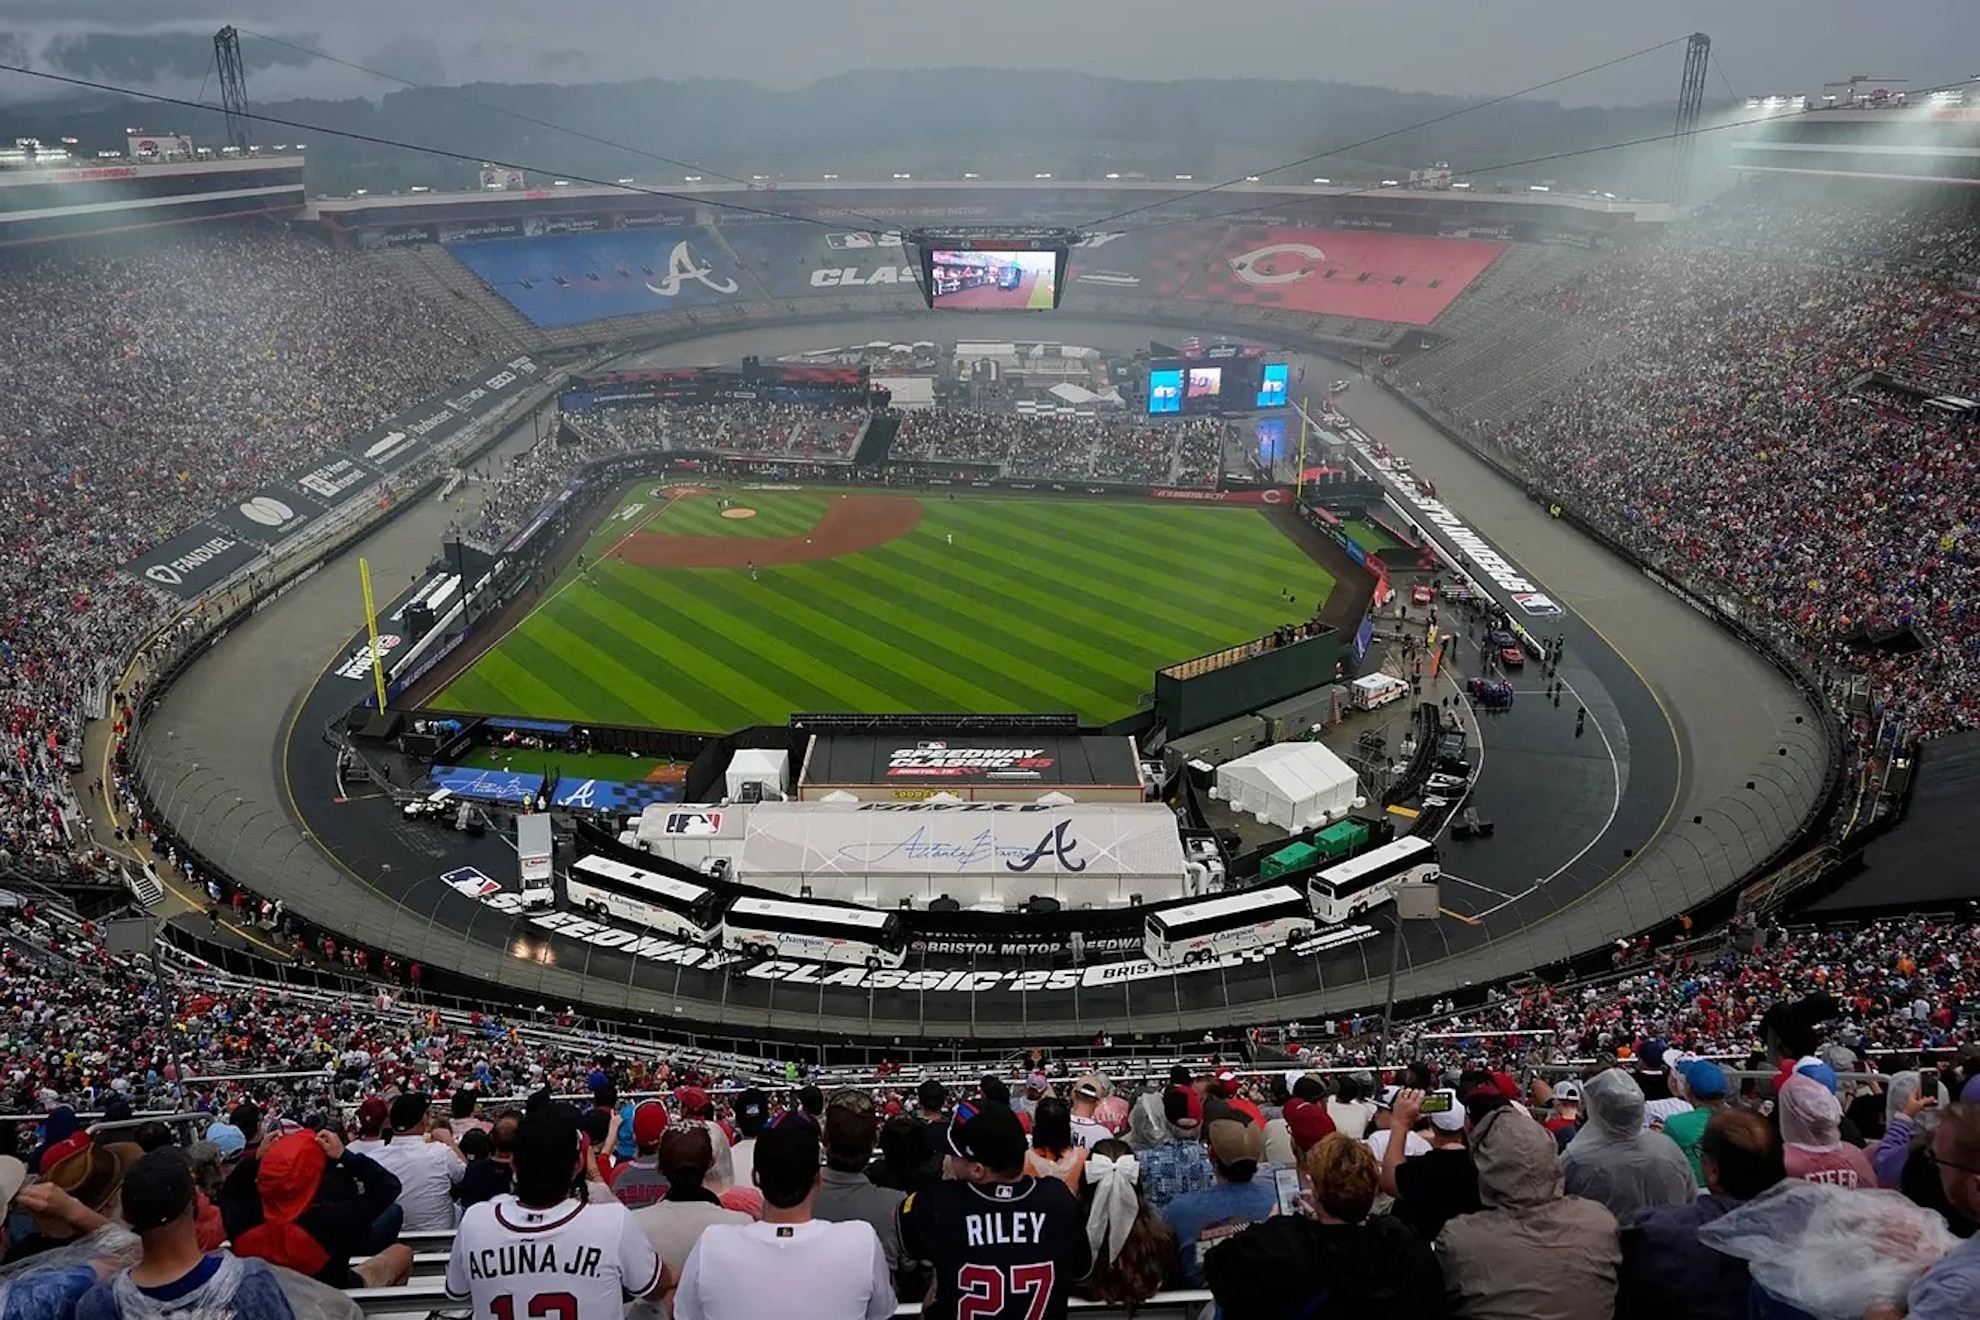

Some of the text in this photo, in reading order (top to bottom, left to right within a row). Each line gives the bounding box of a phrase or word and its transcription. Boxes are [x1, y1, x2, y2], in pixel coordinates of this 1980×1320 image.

[170, 536, 237, 574] FANDUEL
[888, 758, 1014, 768] CLASSIC
[890, 748, 1045, 759] SPEEDWAY
[891, 790, 959, 799] GOODYR
[927, 940, 996, 955] BRISTOL
[1000, 942, 1060, 956] MOTOR
[745, 960, 1004, 991] CLASSIC
[966, 1212, 1046, 1247] RILEY
[469, 1238, 602, 1280] ACUÑA JR.
[957, 1261, 1055, 1320] 27
